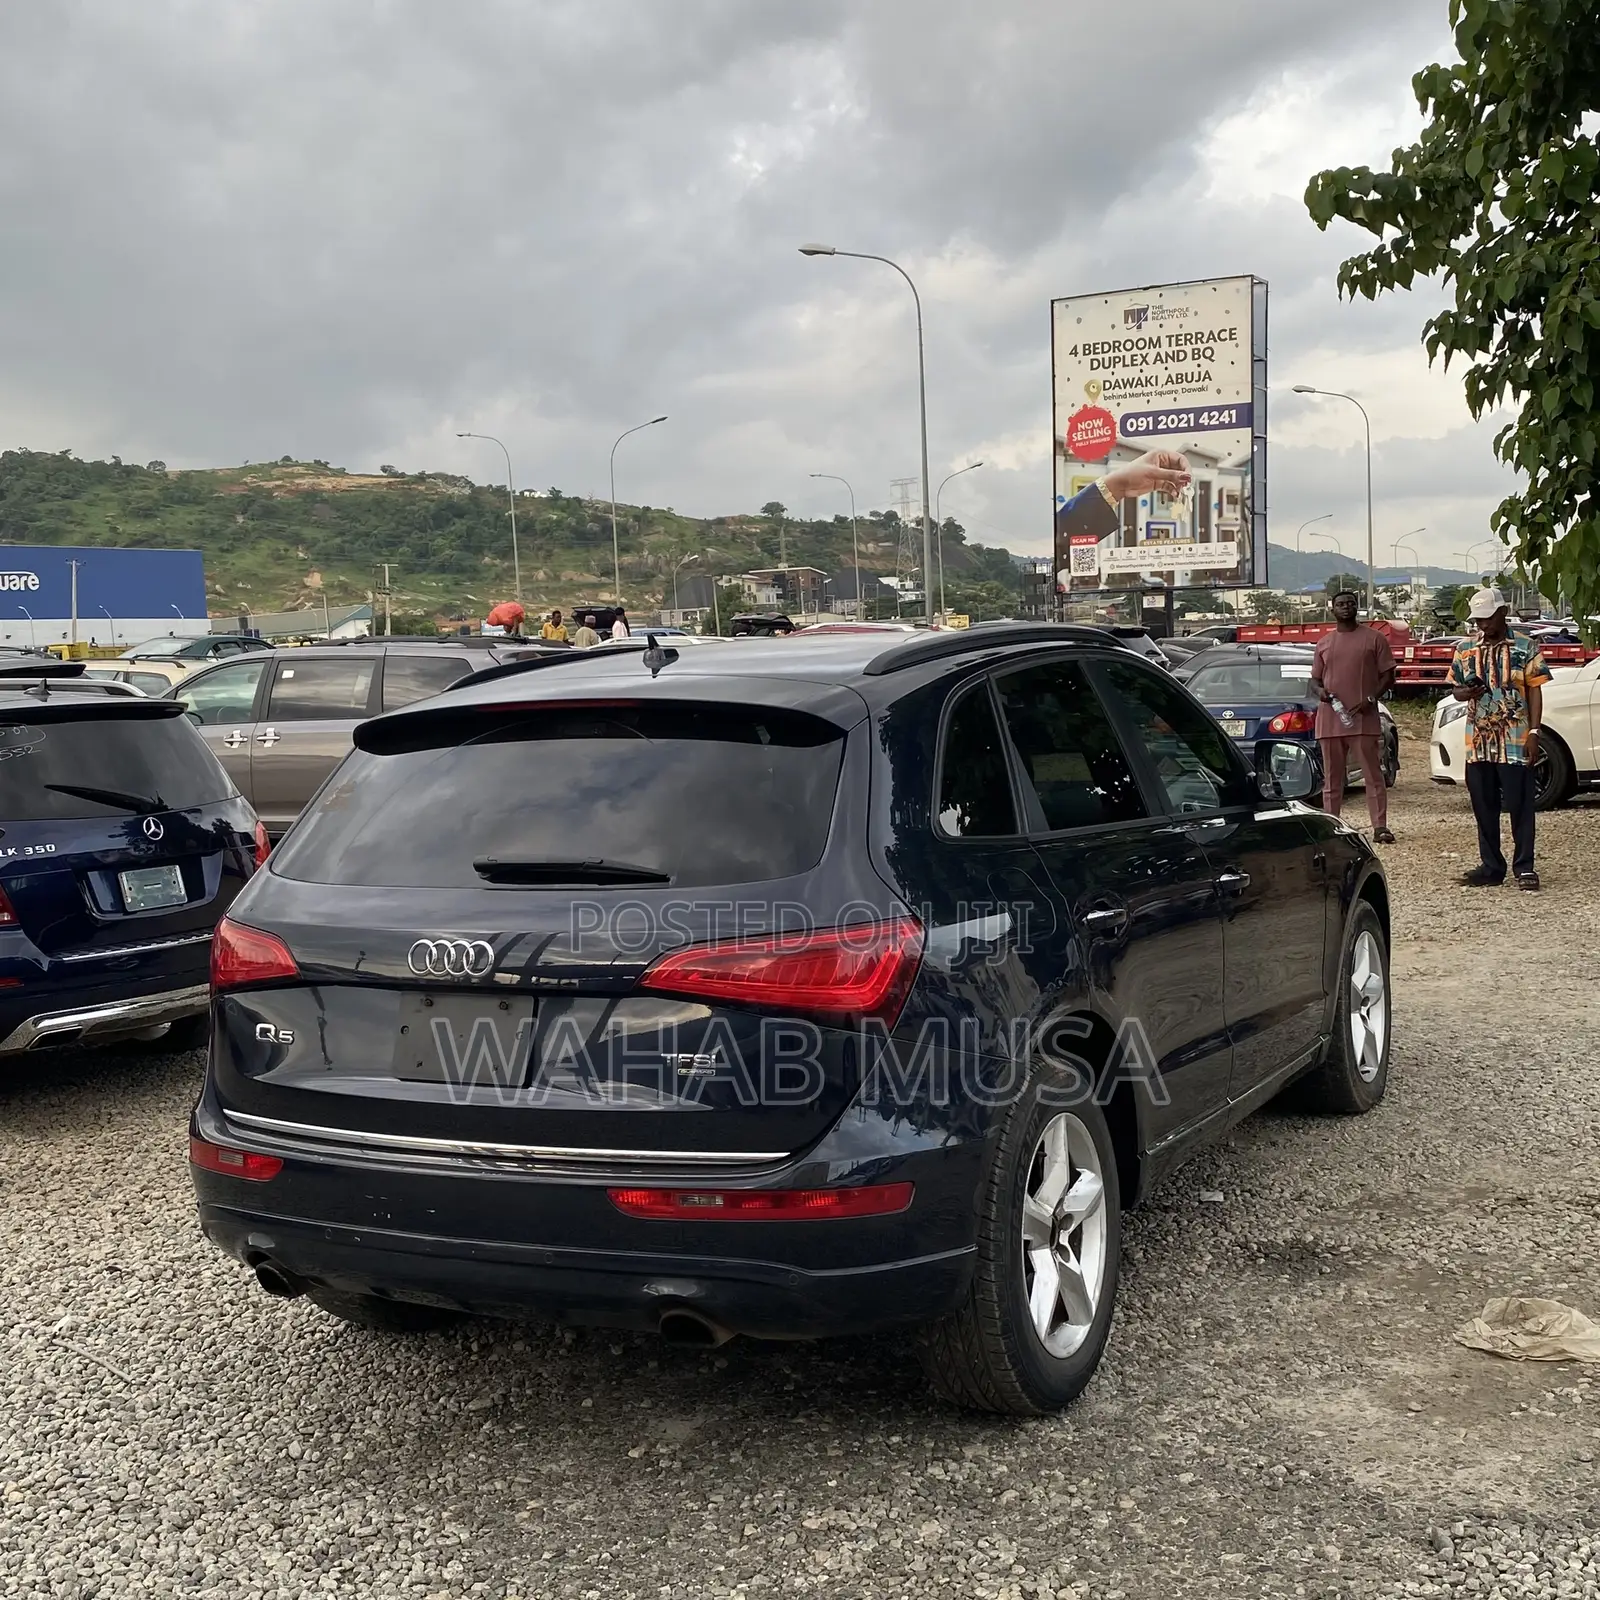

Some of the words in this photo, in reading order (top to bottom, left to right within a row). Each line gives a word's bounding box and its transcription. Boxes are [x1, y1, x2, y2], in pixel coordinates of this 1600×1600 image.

[1152, 307, 1190, 316] NORTHPOLE
[1152, 313, 1175, 321] REALTY
[1069, 344, 1079, 357] 4
[1082, 335, 1162, 357] BEDROOM
[1165, 327, 1238, 348] TERRACE
[1090, 352, 1150, 371] DUPLEX
[1152, 349, 1188, 365] AND
[1191, 346, 1215, 363] BQ
[1102, 374, 1159, 392] DAWAKI
[1128, 390, 1153, 399] Market
[1181, 384, 1209, 394] Dawaki
[1077, 417, 1104, 432] NOW
[1126, 416, 1153, 432] 091
[1157, 413, 1195, 430] 2021
[1198, 409, 1237, 426] 4241
[1072, 426, 1112, 442] SELLING
[23, 843, 56, 855] 350
[255, 1023, 295, 1045] Q5
[660, 1053, 716, 1068] TFSI
